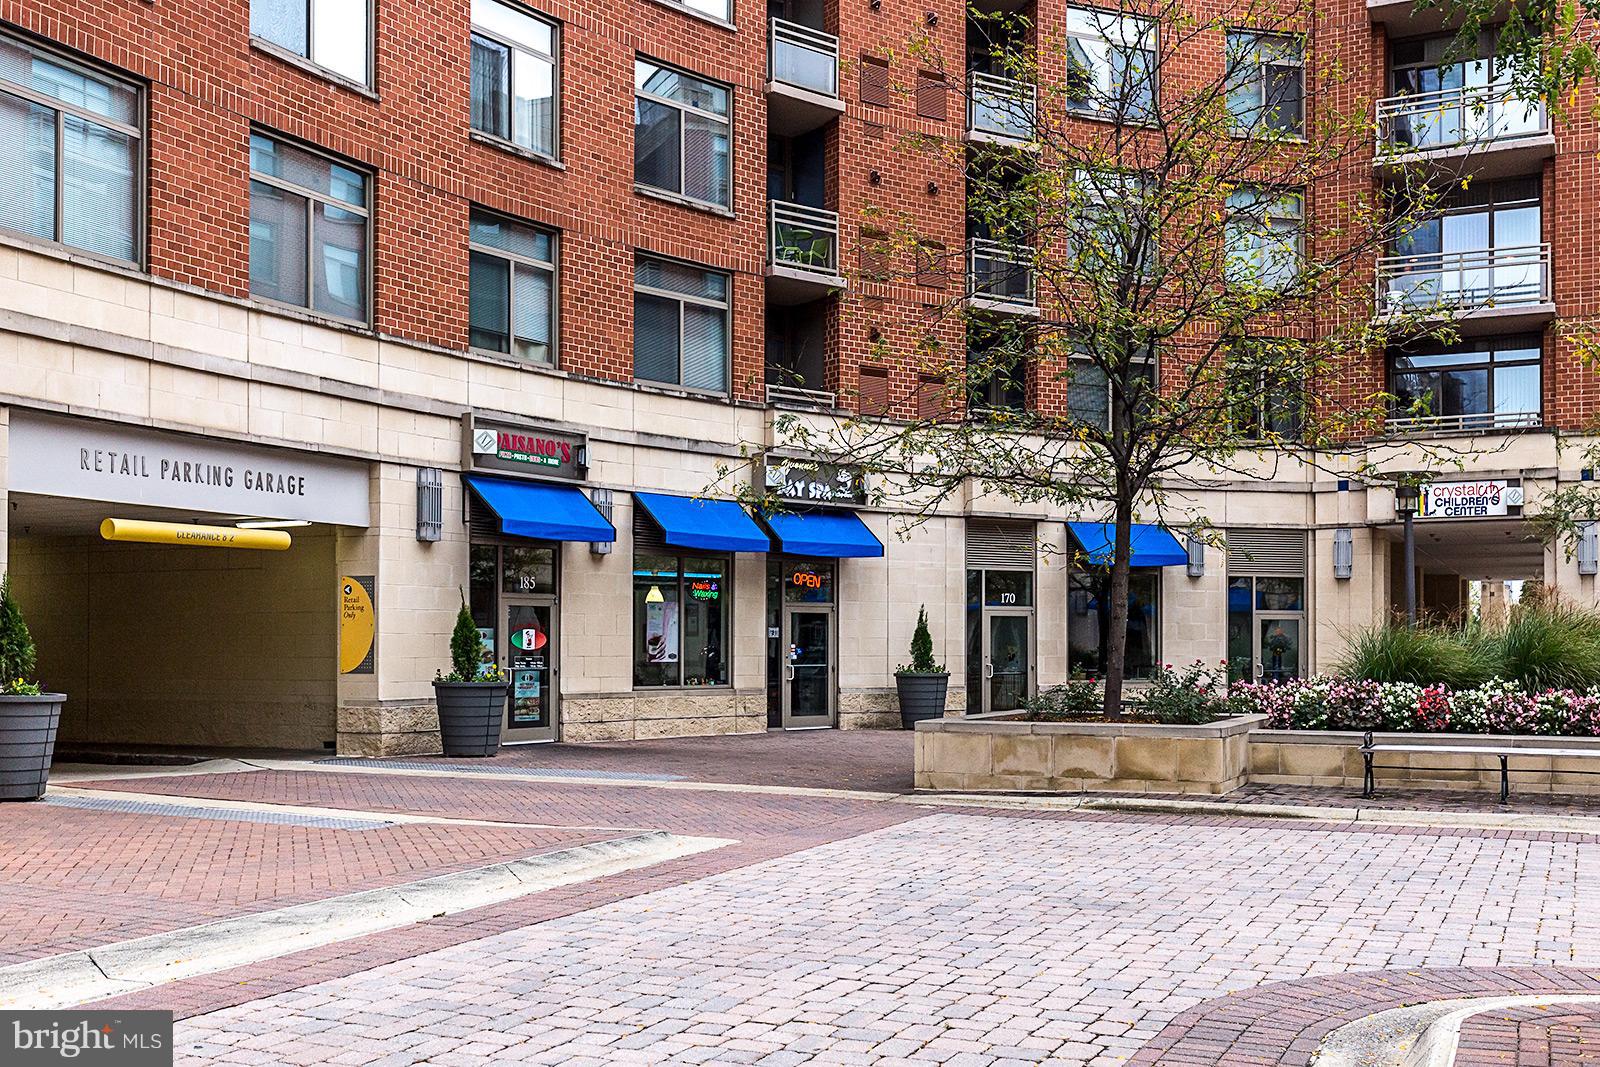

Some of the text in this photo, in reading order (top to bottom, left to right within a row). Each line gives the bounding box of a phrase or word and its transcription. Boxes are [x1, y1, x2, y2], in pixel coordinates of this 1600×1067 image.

[80, 448, 305, 496] RETAIL PARKING GARAGE
[808, 481, 832, 500] SPA
[1435, 495, 1500, 507] CHILDREN'S
[1444, 506, 1488, 516] CENTER
[519, 576, 536, 590] 185
[793, 572, 821, 588] OPEN
[1001, 593, 1016, 604] 170
[343, 603, 365, 613] Parking
[343, 611, 356, 620] Only
